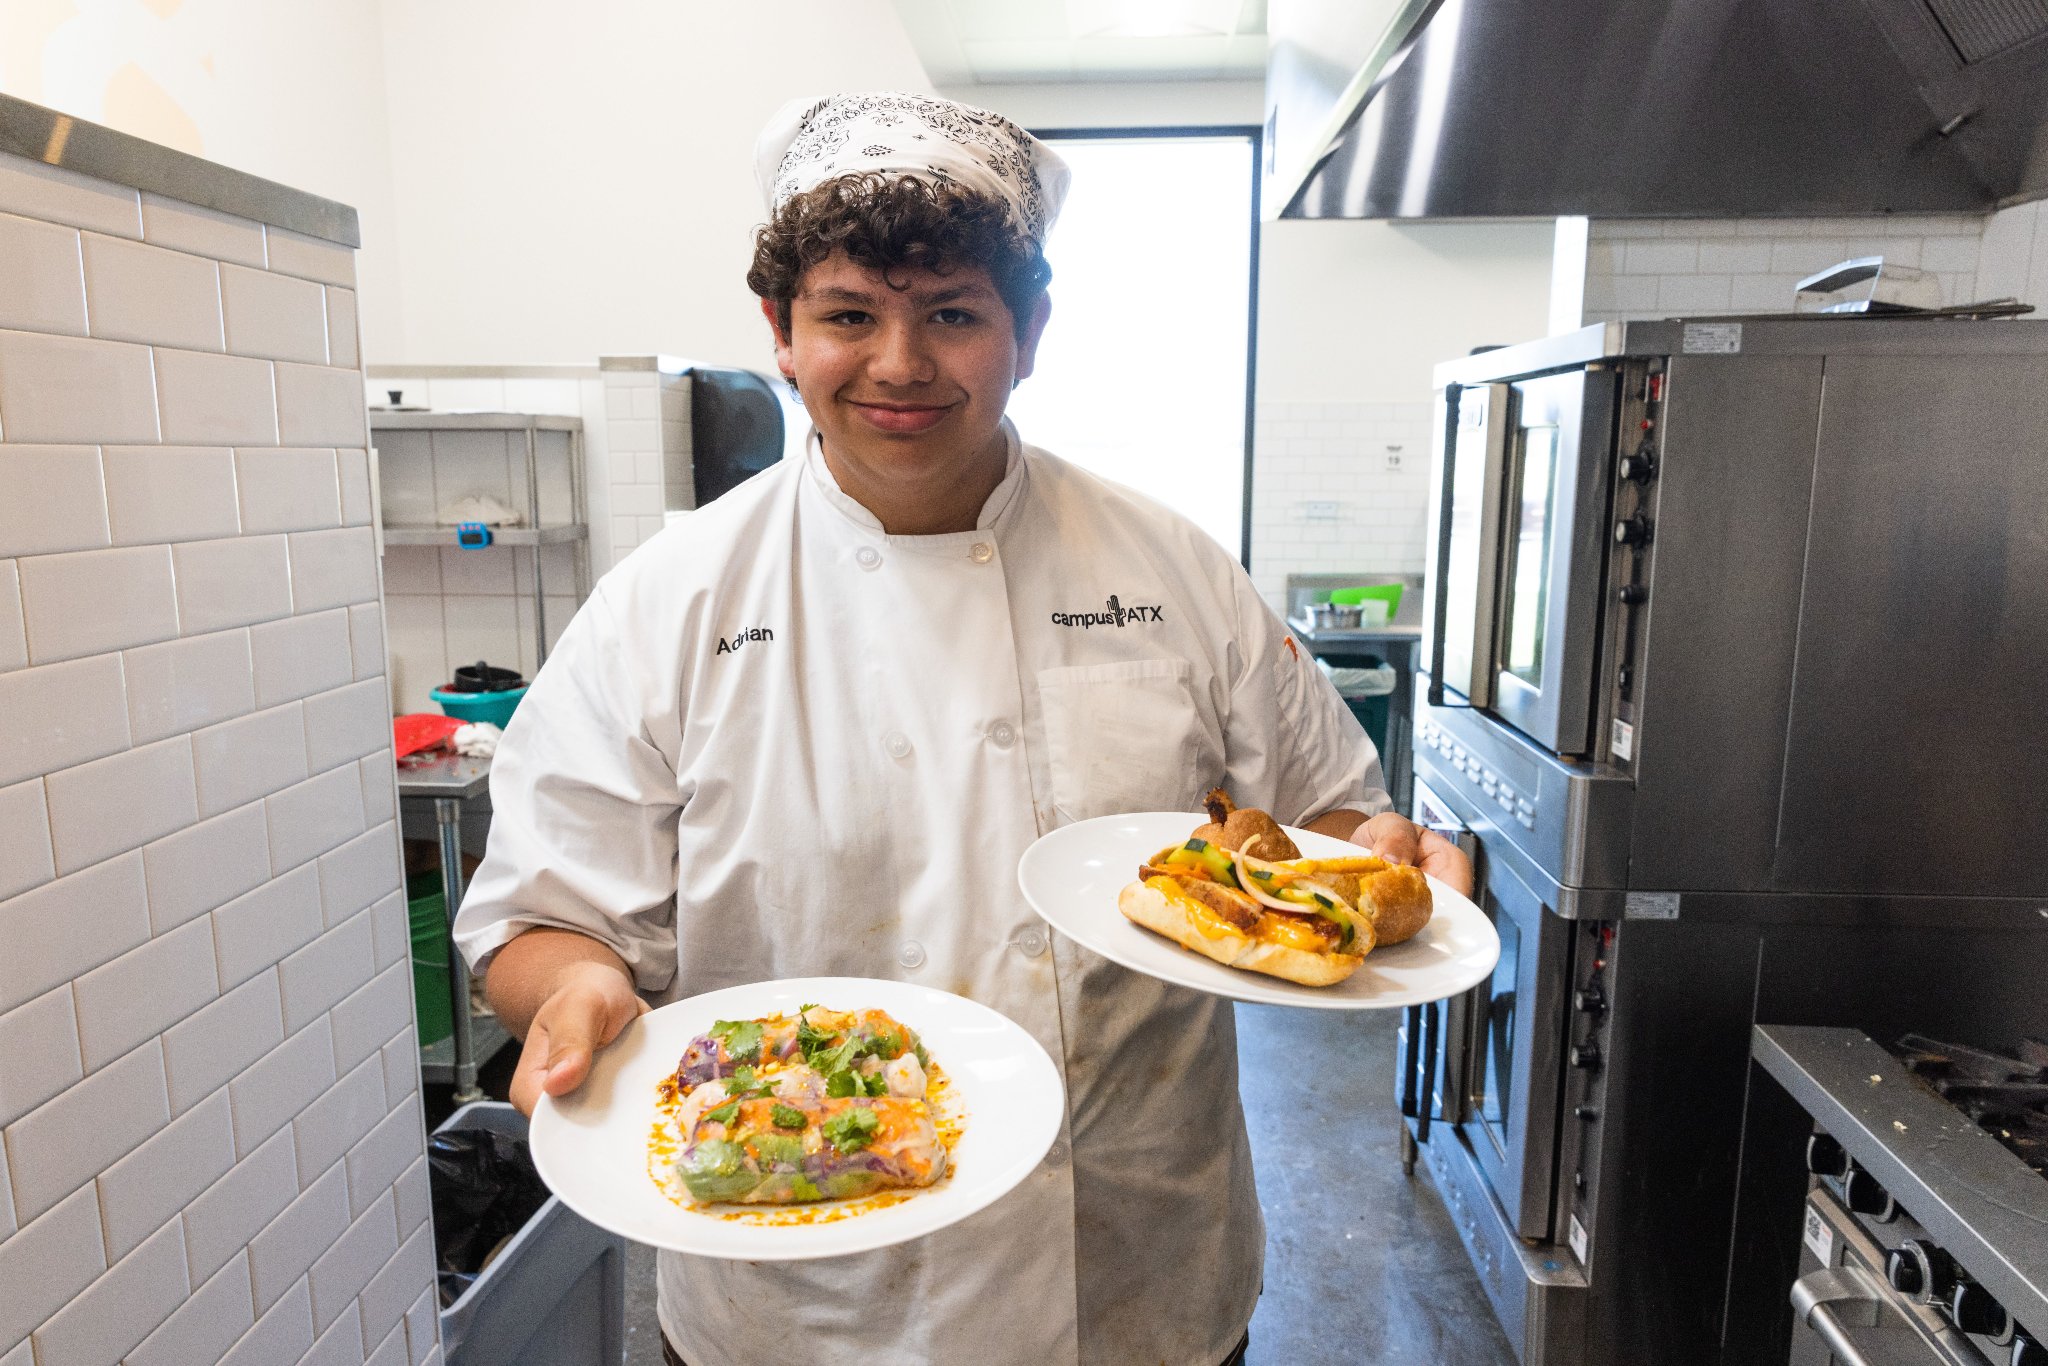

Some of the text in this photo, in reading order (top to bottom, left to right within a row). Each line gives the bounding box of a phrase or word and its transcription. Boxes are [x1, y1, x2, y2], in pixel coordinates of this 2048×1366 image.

[1051, 605, 1164, 629] campus ATX
[716, 626, 774, 655] Adrian
